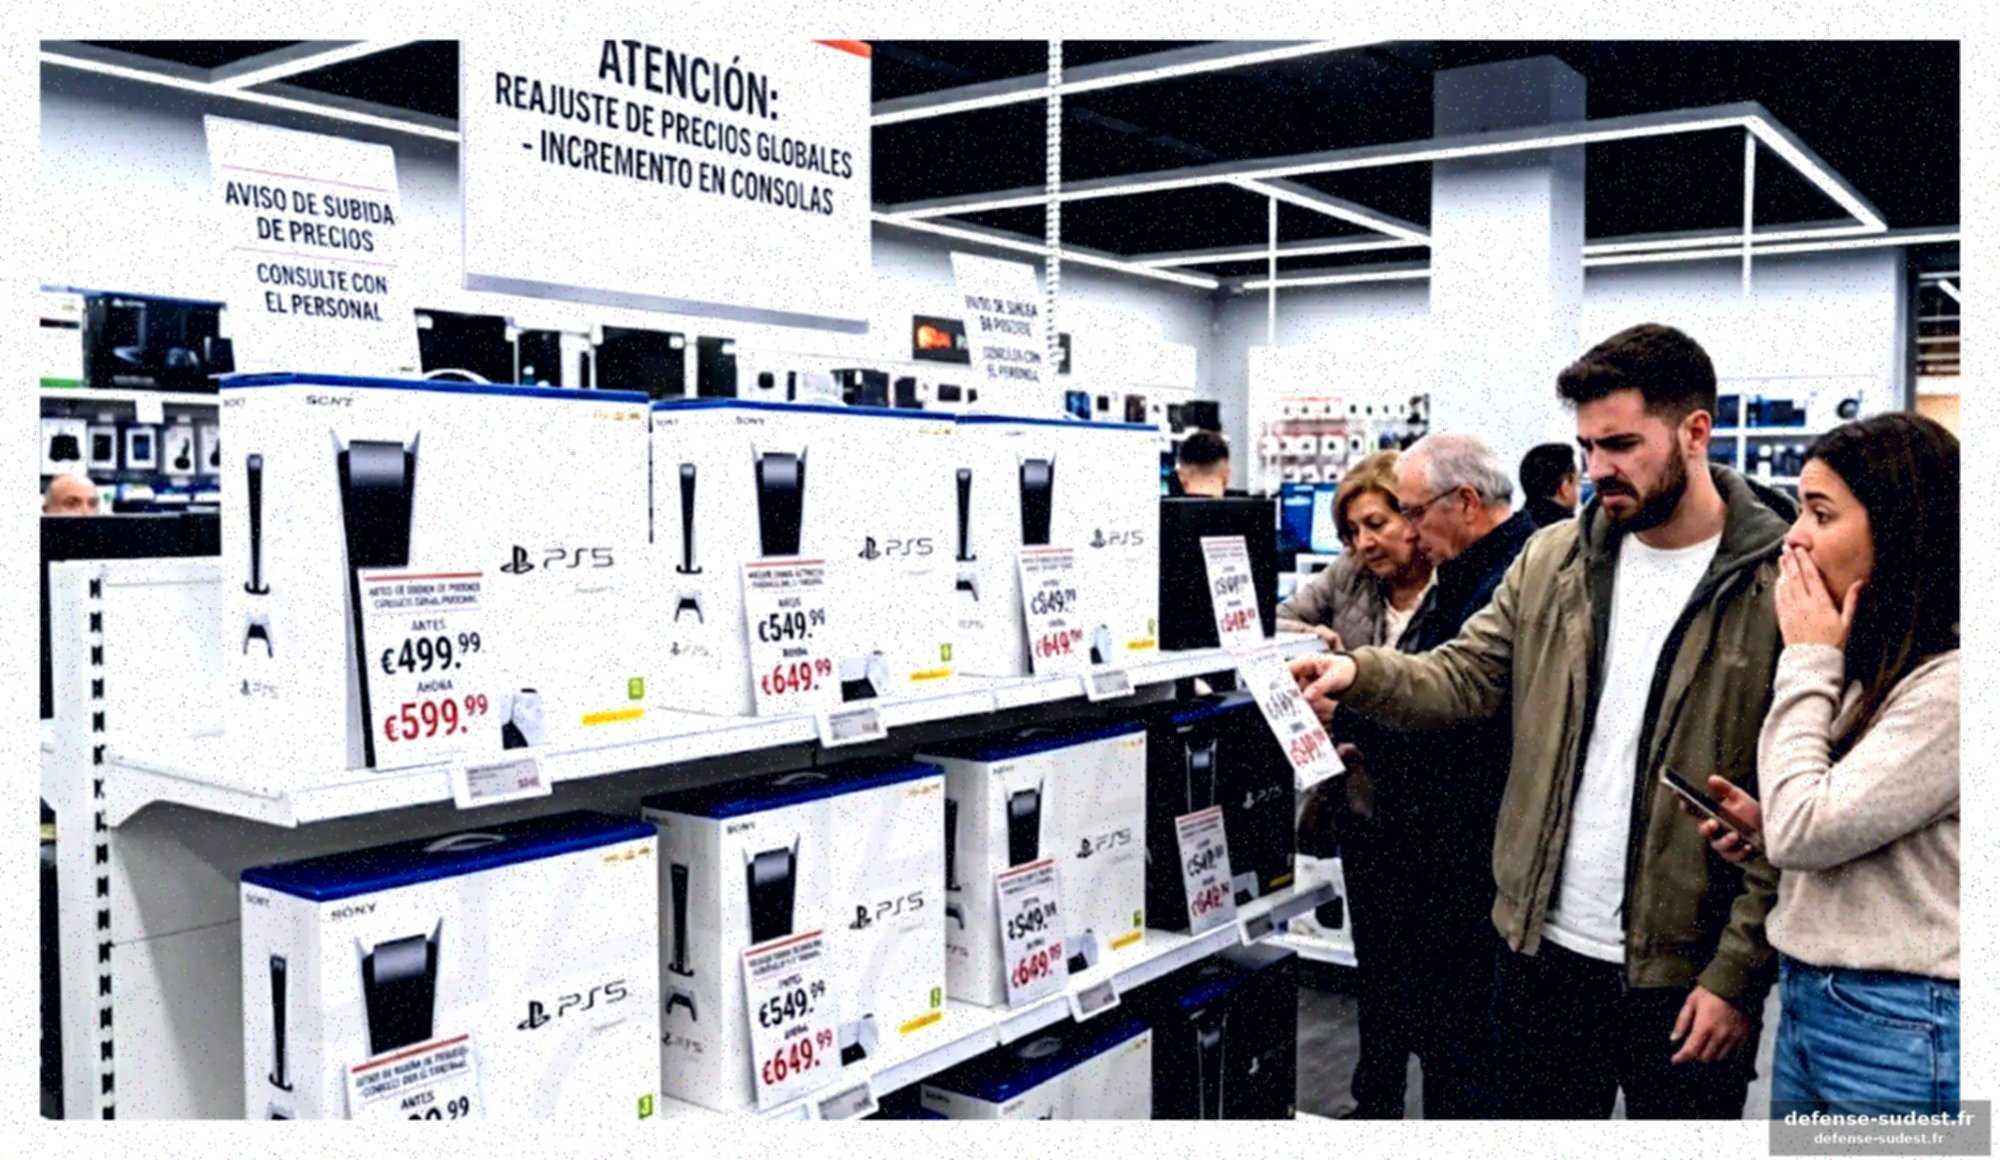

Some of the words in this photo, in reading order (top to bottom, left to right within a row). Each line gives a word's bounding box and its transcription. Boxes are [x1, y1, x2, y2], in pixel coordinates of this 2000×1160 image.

[599, 40, 779, 120] ATENCIÓN:
[496, 72, 619, 129] REAJUSTE
[625, 102, 655, 137] DE
[661, 109, 752, 158] PRECIOS
[756, 132, 853, 179] GLOBALES
[540, 129, 693, 188] INCREMENTO
[699, 163, 726, 194] EN
[731, 169, 834, 215] CONSOLAS
[225, 181, 287, 212] AVISO
[292, 191, 319, 215] DE
[323, 195, 395, 225] SUBIDA
[256, 216, 285, 241] DE
[289, 221, 374, 252] PRECIOS
[256, 263, 349, 292] CONSULTE
[351, 273, 388, 295] CON
[264, 291, 287, 314] EL
[291, 293, 383, 322] PERSONAL
[543, 547, 614, 569] PS5
[886, 538, 933, 556] PS5
[381, 632, 481, 675] €499.99
[384, 694, 488, 742] €599.99
[876, 891, 924, 920] PS5
[558, 979, 630, 1017] PS5
[762, 1029, 832, 1085] €649.99
